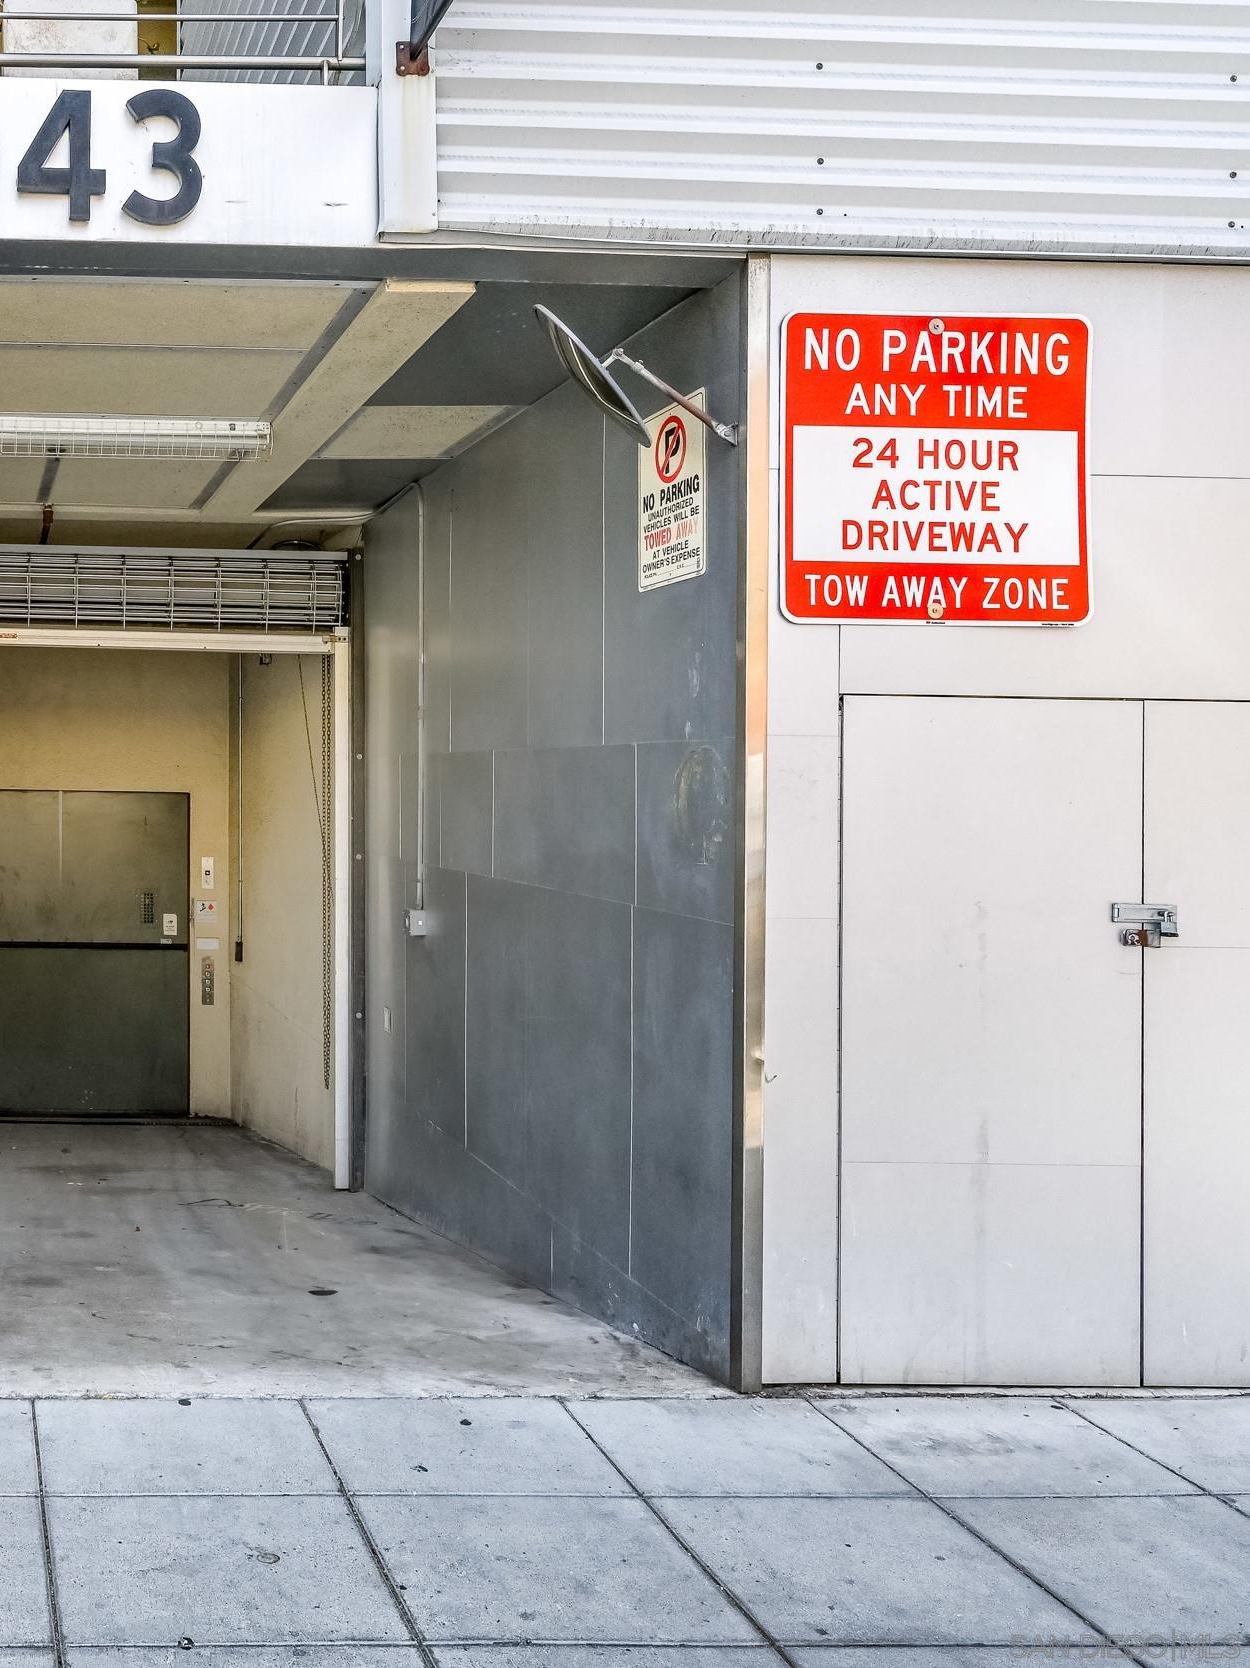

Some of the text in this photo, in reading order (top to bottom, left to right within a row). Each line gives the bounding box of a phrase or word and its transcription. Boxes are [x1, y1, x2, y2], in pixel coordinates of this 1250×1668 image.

[804, 327, 1071, 377] NO PARKING
[844, 382, 1029, 419] ANY TIME
[851, 436, 1020, 472] 24 HOUR
[642, 473, 700, 514] NO PARKING
[647, 496, 694, 522] UNAUTHORIZED
[871, 479, 1001, 512] ACTIVE
[643, 504, 700, 534] VEHICLES WILL BE
[644, 517, 699, 552] TOWED AWAY
[841, 519, 1029, 553] DRIVEWAY
[642, 556, 670, 574] OWNER'S
[670, 546, 701, 565] EXPENSE
[652, 539, 689, 561] AT VEHICLE
[804, 573, 1070, 610] TOW AWAY ZONE
